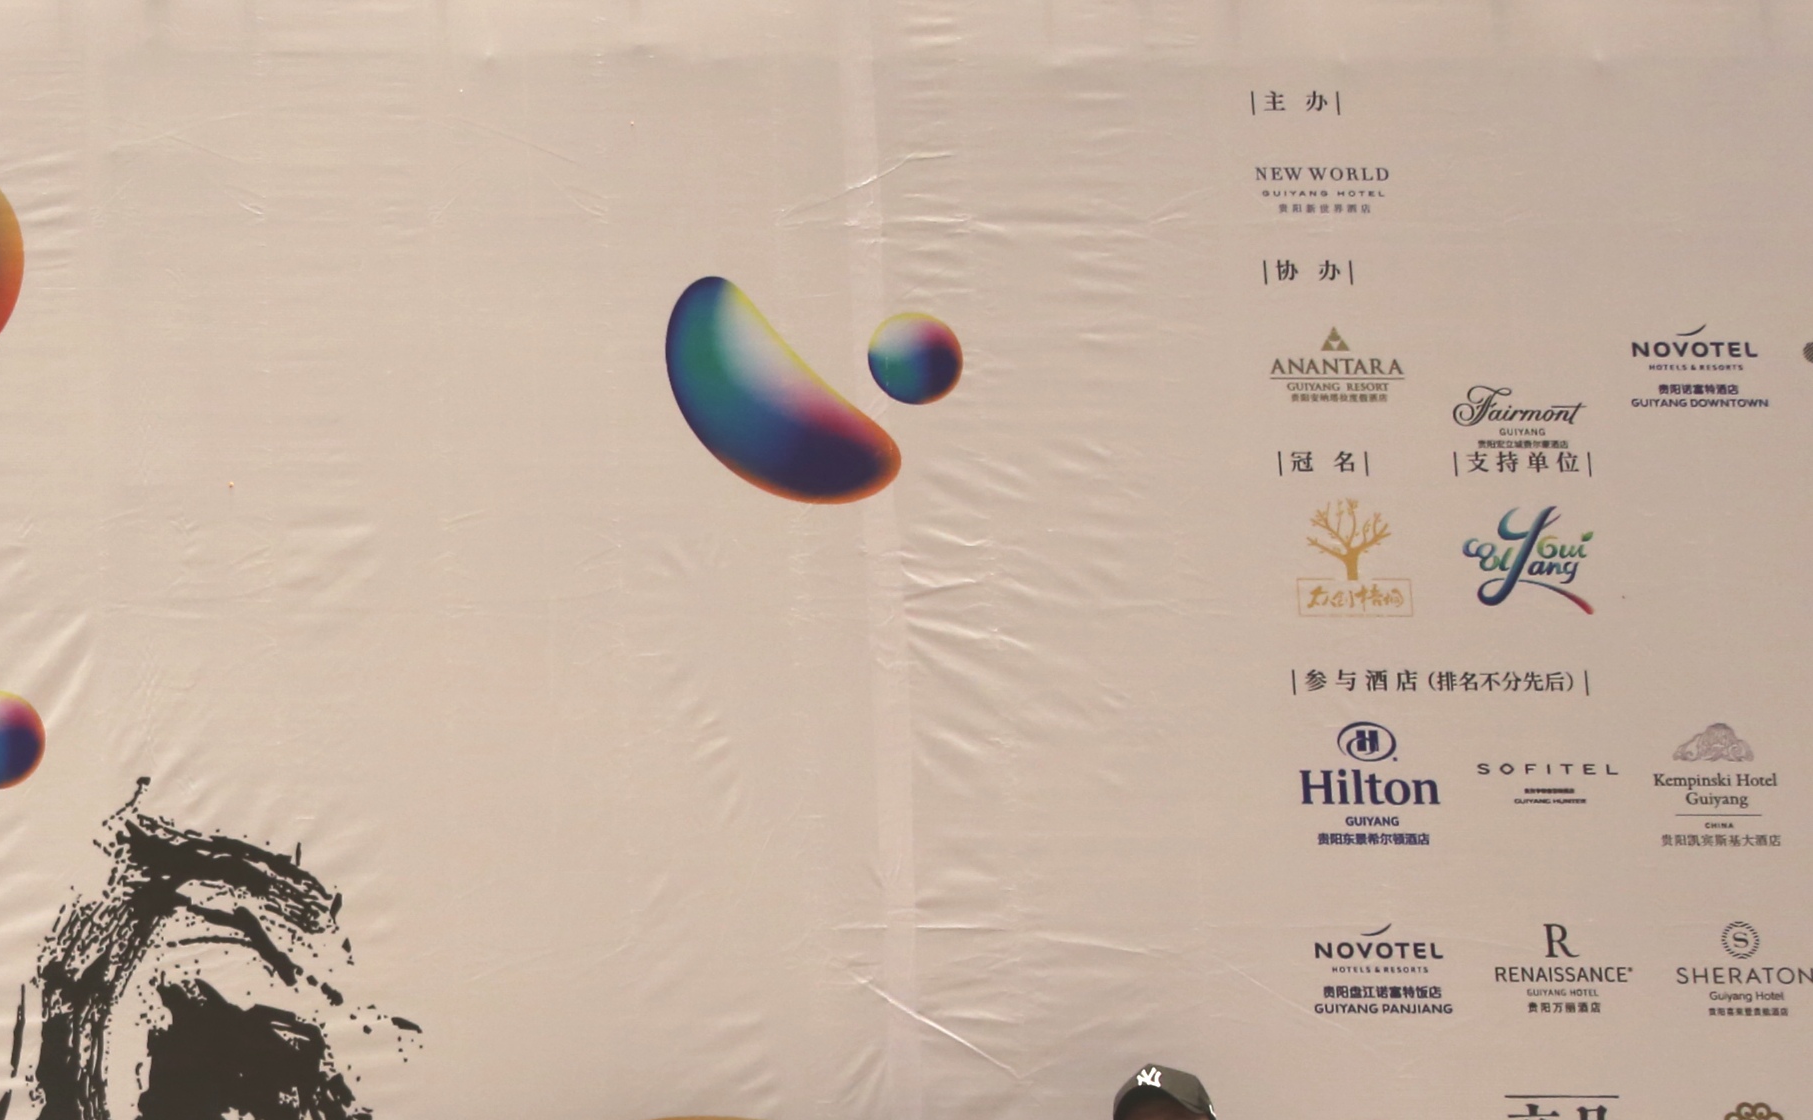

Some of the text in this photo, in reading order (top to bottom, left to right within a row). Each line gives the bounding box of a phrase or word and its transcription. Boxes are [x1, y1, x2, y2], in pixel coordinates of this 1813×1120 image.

[1255, 166, 1390, 181] NEW WORLD
[1261, 190, 1385, 198] GUIYANG HOTEL
[1631, 341, 1759, 358] NOVOTEL
[1270, 358, 1405, 375] ANANTARA
[1286, 382, 1389, 392] GUIYANG RESORT
[1452, 385, 1588, 427] Fairmont
[1631, 398, 1770, 408] GUIYANG DOWNTOWN
[1499, 428, 1546, 436] GUIYANG
[1466, 451, 1580, 473] 支持单位
[1476, 762, 1619, 775] SOFITEL
[1299, 768, 1441, 806] Hilton
[1653, 772, 1778, 790] Kempinski Hotel
[1685, 791, 1749, 809] Guiyang
[1345, 816, 1400, 827] GUIYANG
[1314, 941, 1444, 959] NOVOTEL
[1676, 967, 1813, 985] SHERATON
[1526, 989, 1599, 997] GUIYANG HOTEL
[1709, 991, 1785, 1003] Guiyang Hotel
[1314, 1003, 1453, 1014] GUIYANG PANJIANG
